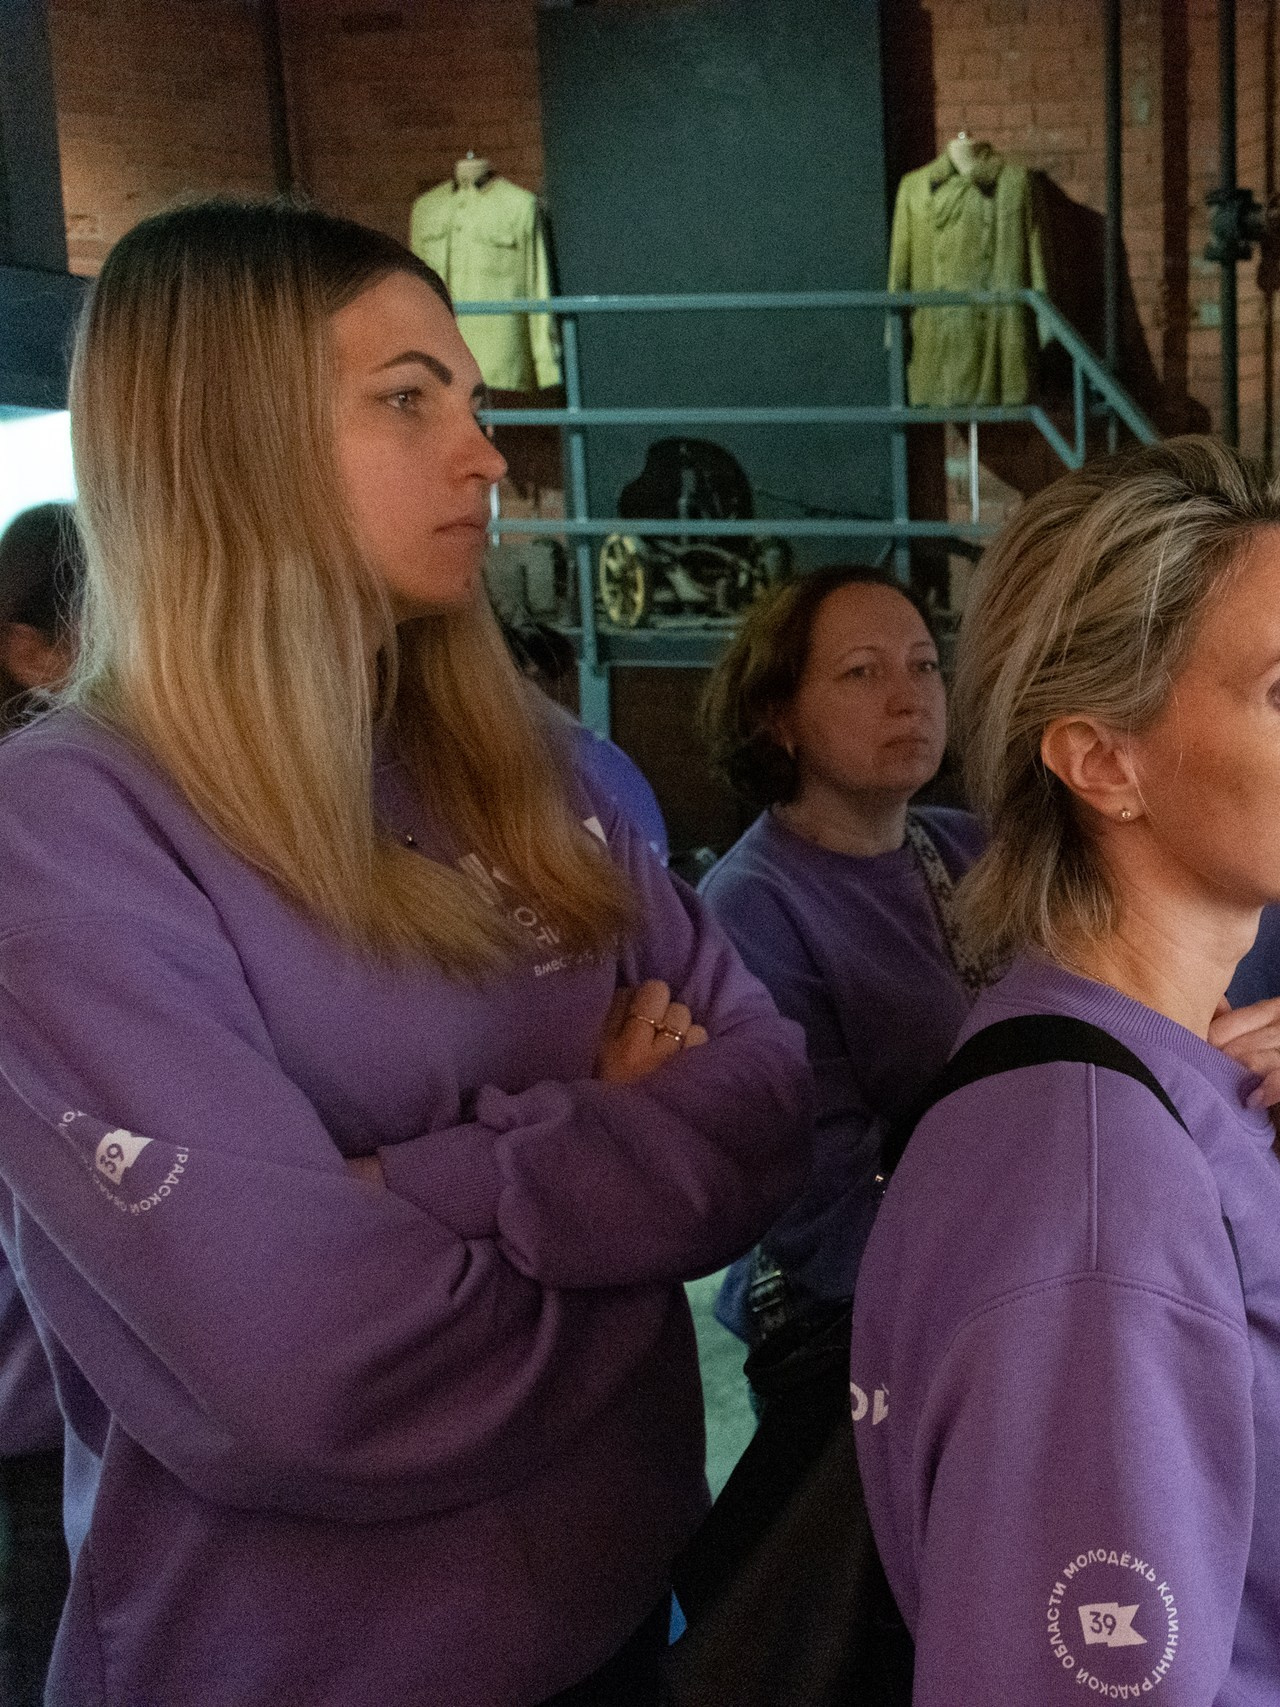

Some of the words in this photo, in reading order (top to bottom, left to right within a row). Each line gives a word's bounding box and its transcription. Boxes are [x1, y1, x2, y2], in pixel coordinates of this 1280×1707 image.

[100, 1143, 125, 1175] 39
[1063, 1549, 1156, 1582] МОЛОДЁЖЬ
[1047, 1581, 1075, 1669] ОБЛАСТИ
[1076, 1581, 1178, 1699] КАЛИНИНГРАДСКОЙ
[1089, 1611, 1117, 1636] 39
